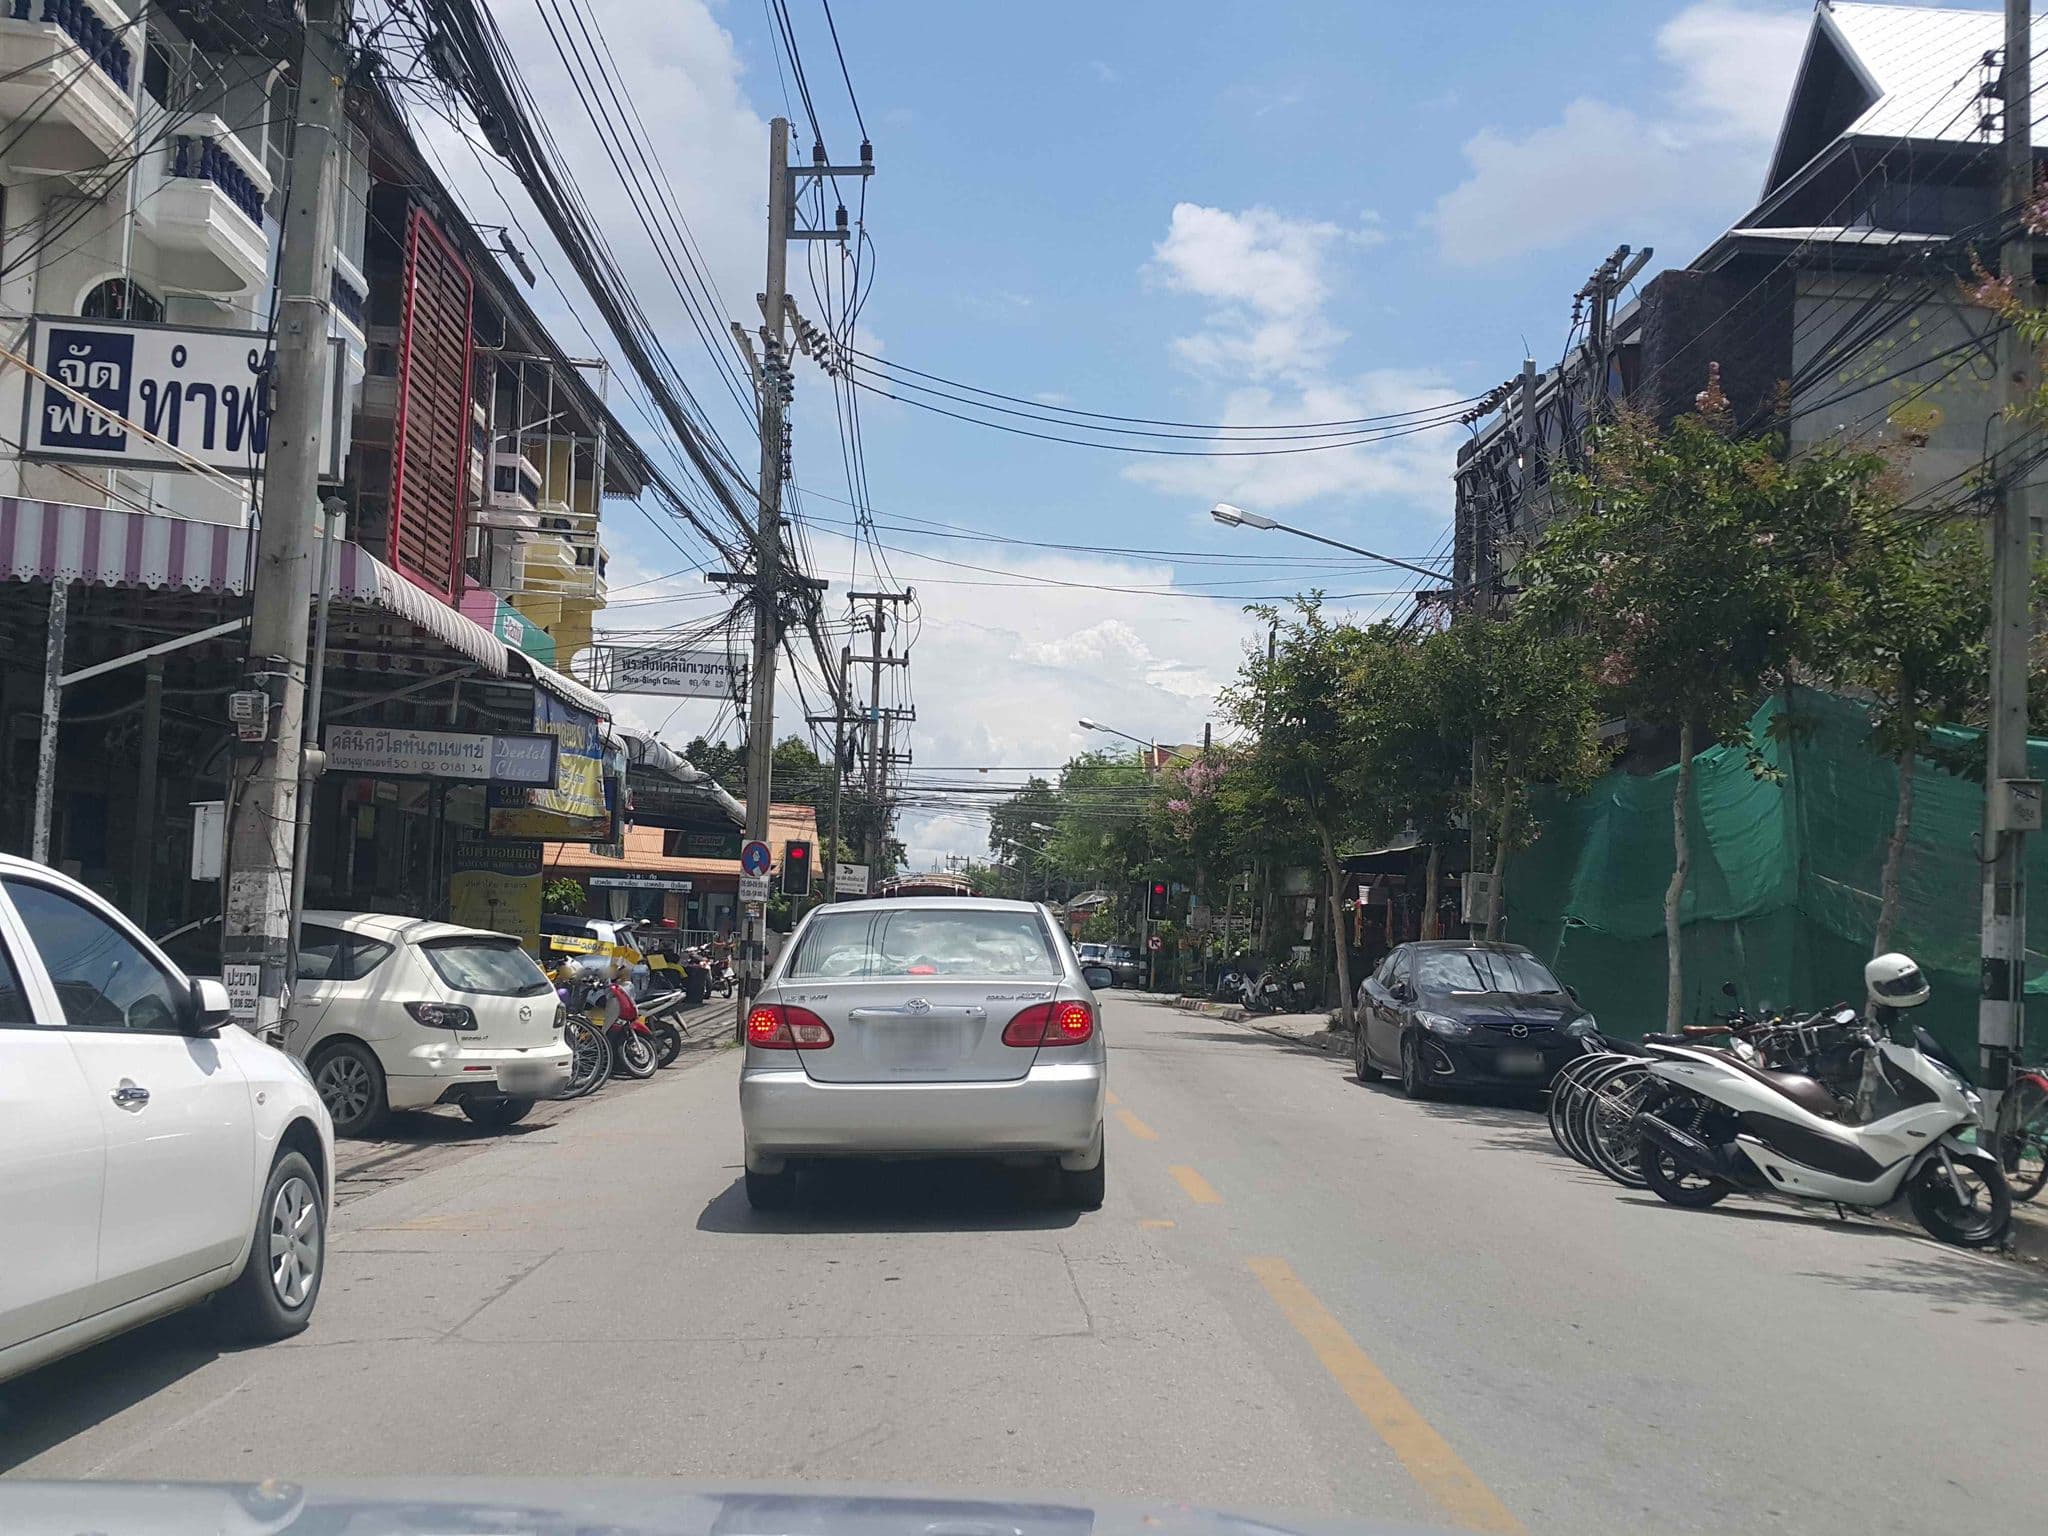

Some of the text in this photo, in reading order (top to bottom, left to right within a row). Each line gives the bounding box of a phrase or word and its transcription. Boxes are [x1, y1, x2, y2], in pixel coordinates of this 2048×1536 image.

[57, 344, 121, 391] จัด
[140, 344, 276, 454] ทำฟั
[46, 391, 124, 438] ฟัน
[663, 677, 681, 686] Clinic
[495, 737, 546, 760] Dental
[495, 760, 541, 778] Clinic
[228, 968, 257, 986] ปะยาง
